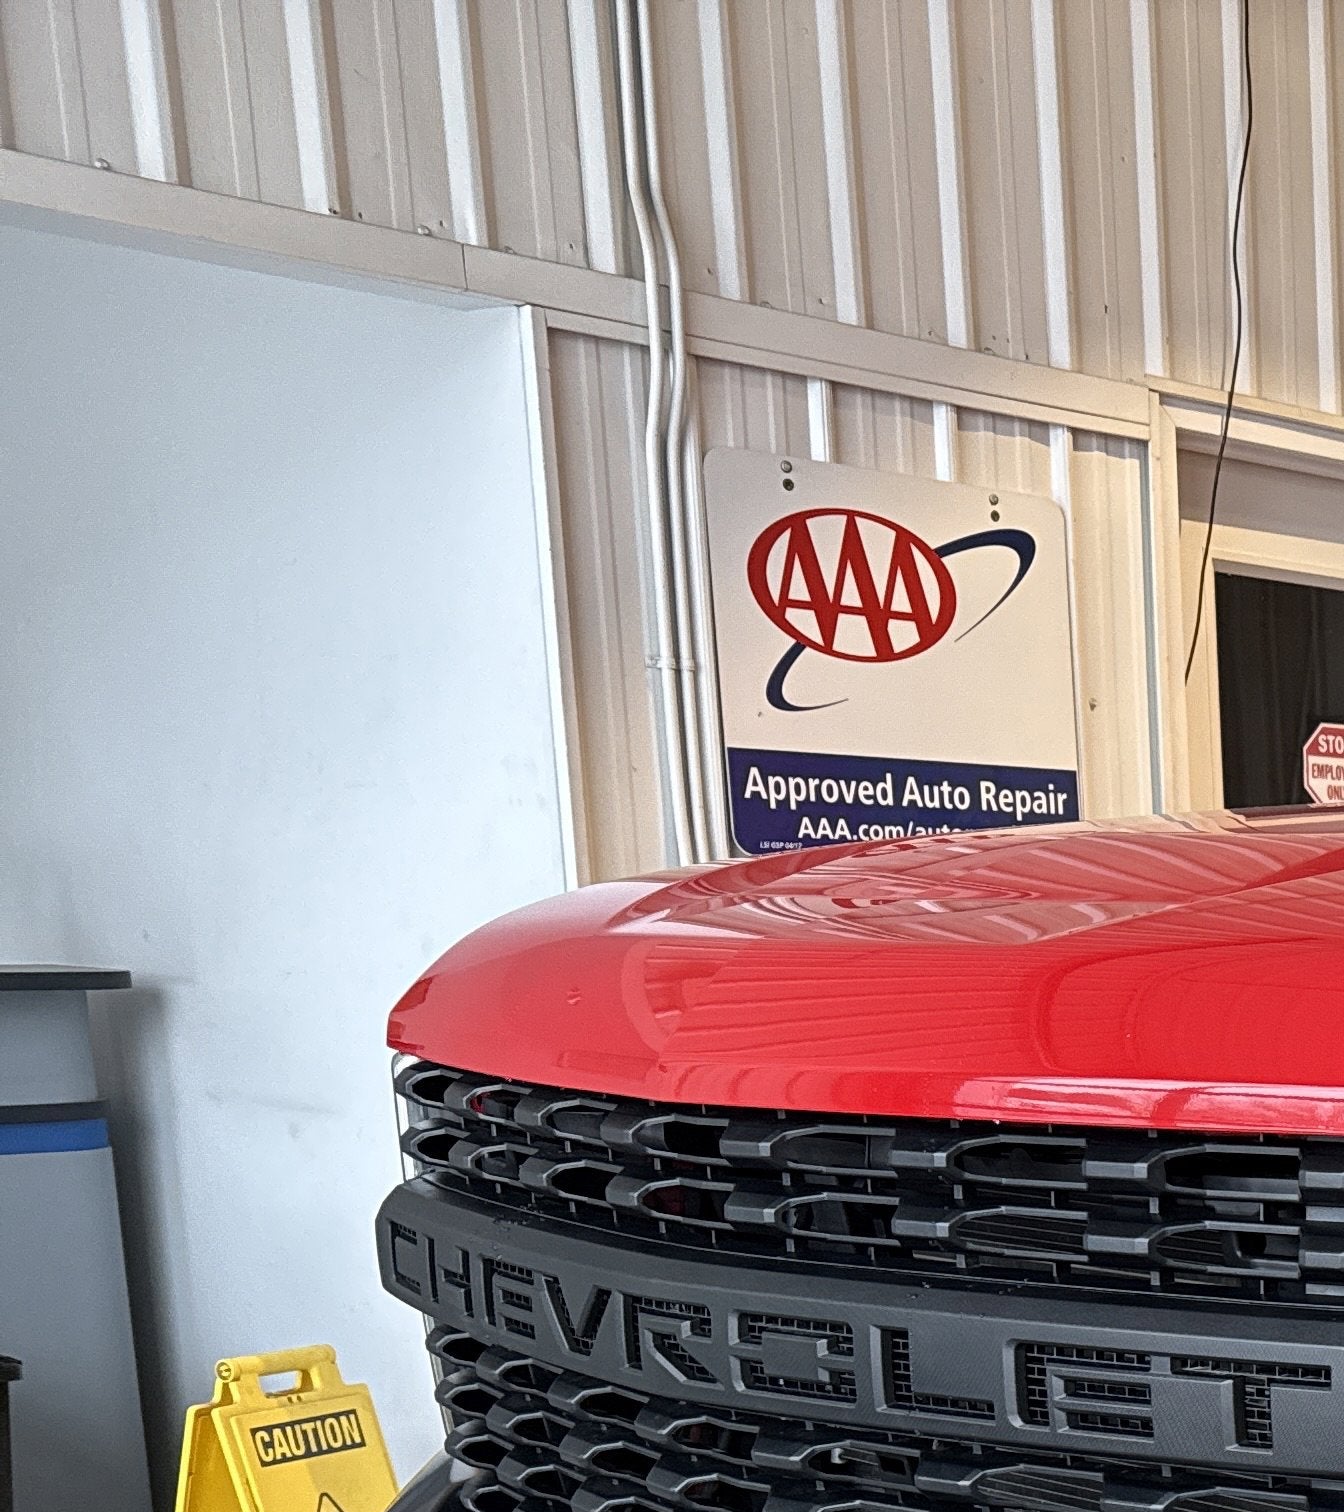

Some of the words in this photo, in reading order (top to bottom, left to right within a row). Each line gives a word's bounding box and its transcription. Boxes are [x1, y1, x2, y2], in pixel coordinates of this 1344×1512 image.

[775, 514, 938, 660] AAA
[744, 766, 894, 808] Approved
[902, 776, 971, 810] Auto
[981, 780, 1067, 820] Repair
[388, 1216, 1334, 1452] CHEVROLET
[254, 1414, 362, 1463] CAUTION
